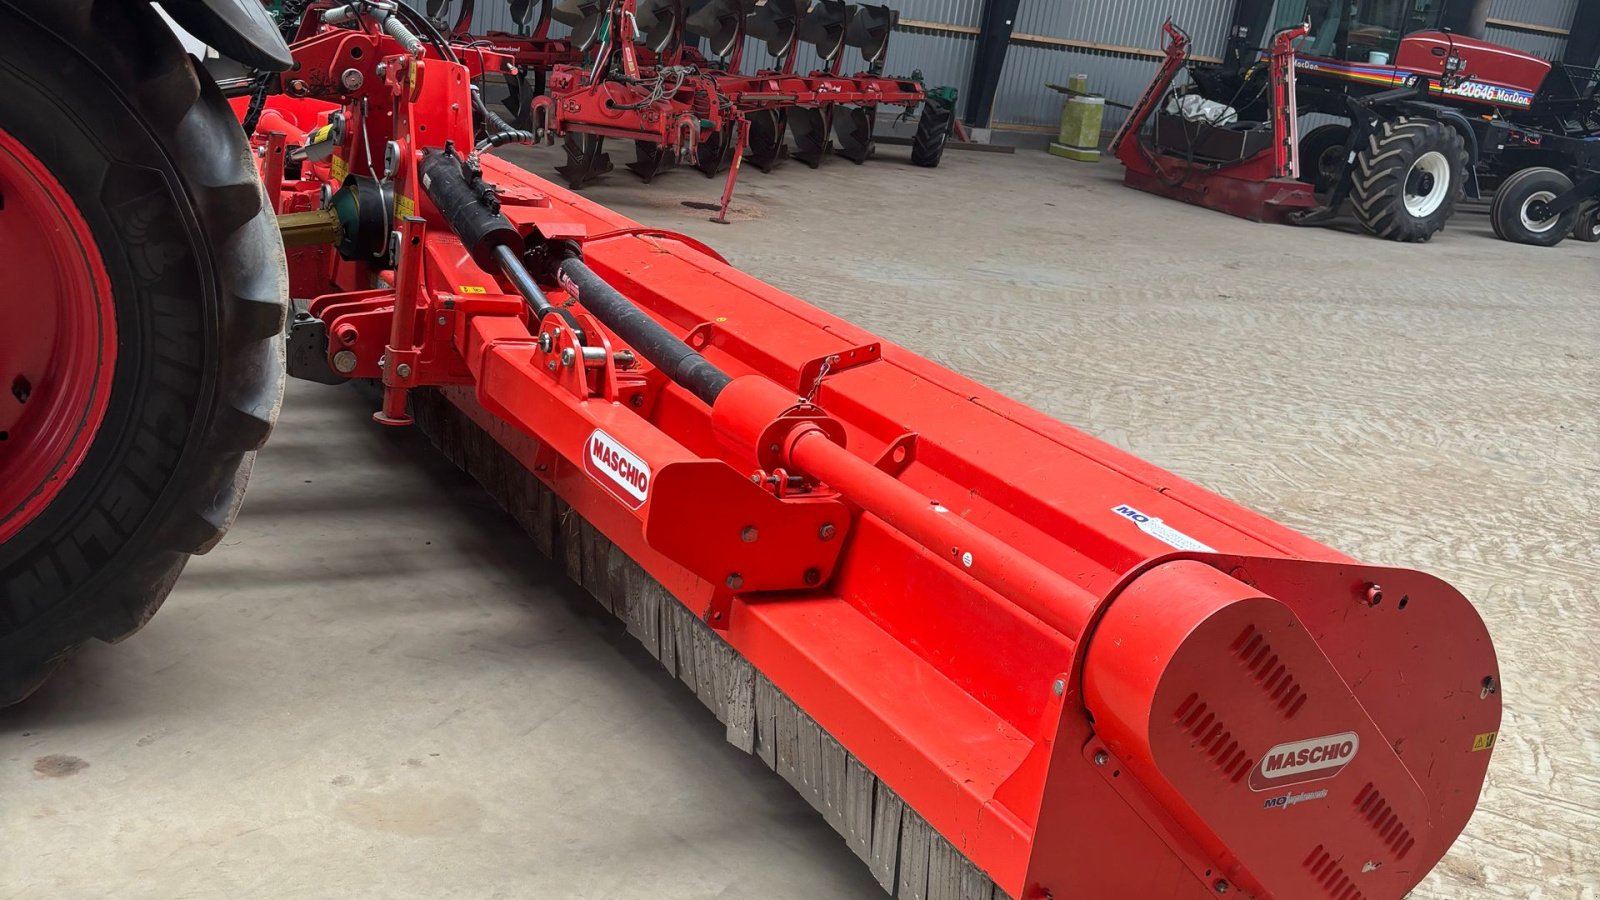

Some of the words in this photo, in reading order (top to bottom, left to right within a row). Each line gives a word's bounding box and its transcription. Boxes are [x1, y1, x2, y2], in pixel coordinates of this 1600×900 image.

[1497, 91, 1530, 105] MacDon
[7, 294, 202, 630] MICHELIN
[593, 437, 648, 493] MASCHIO
[1116, 506, 1149, 523] MO
[1266, 741, 1353, 772] MASCHIO
